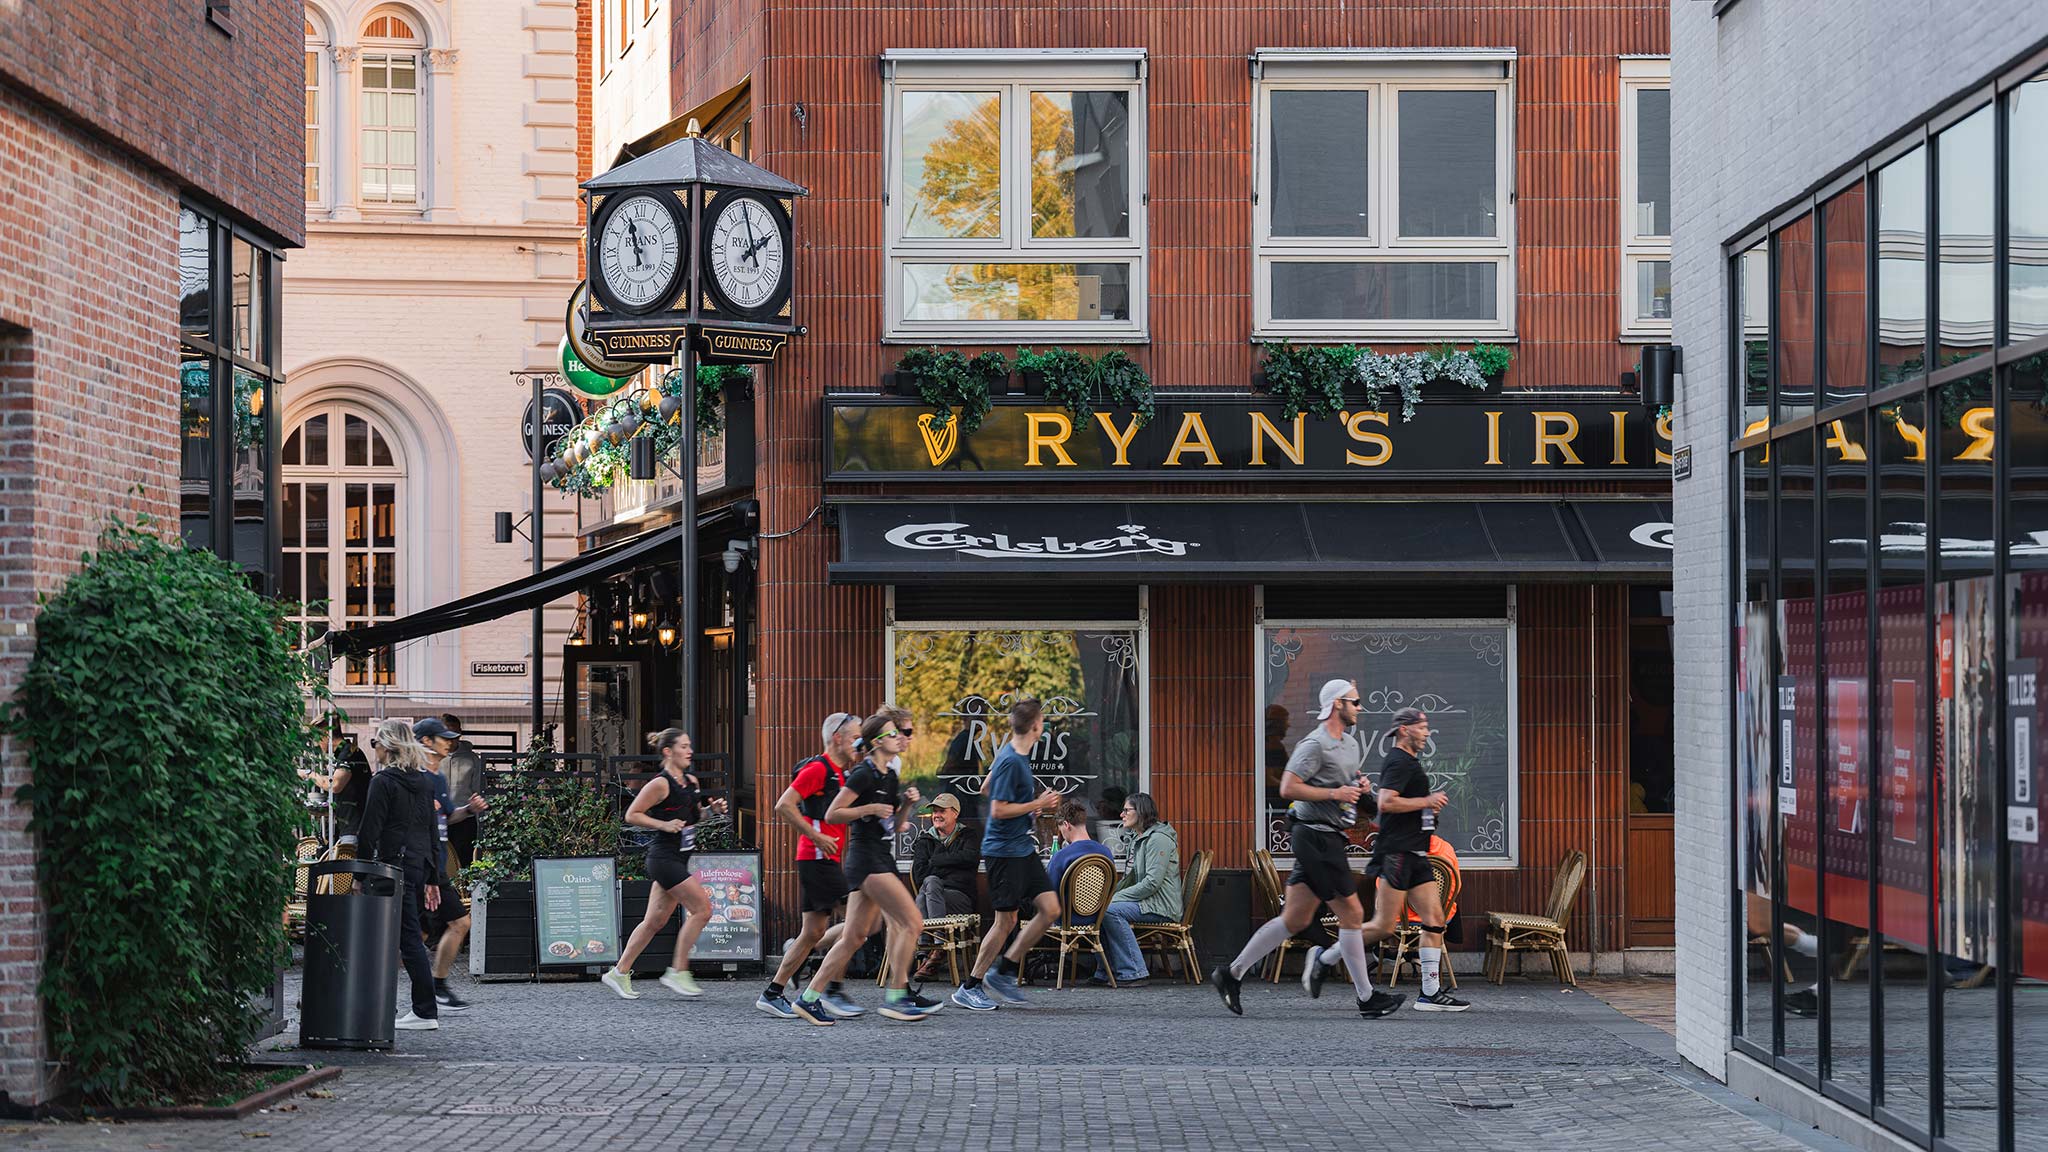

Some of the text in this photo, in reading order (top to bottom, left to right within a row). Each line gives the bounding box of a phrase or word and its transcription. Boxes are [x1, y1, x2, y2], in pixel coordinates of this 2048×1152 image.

[634, 205, 646, 218] XII
[610, 334, 671, 349] GUINNESS
[714, 335, 772, 352] GUINNESS
[1024, 411, 1393, 466] RYAN'S
[885, 523, 1187, 557] Carlsberg
[475, 664, 524, 672] Fisketorvet
[964, 720, 1070, 770] Ryns
[563, 874, 591, 883] Mains
